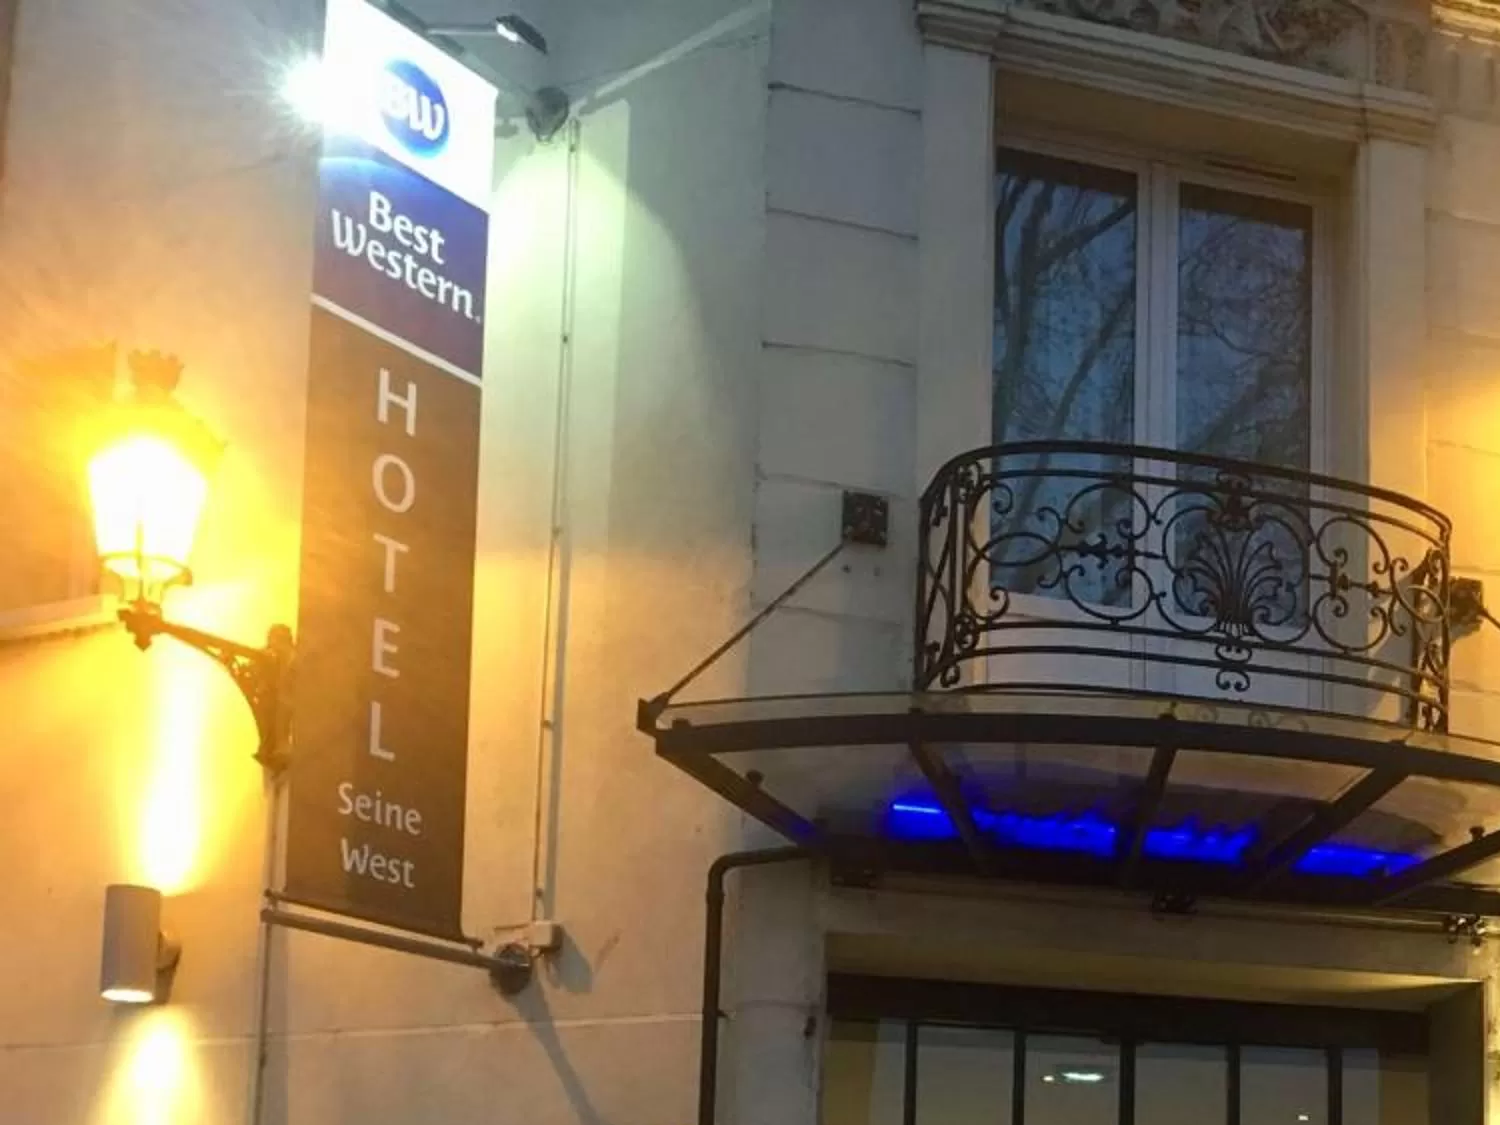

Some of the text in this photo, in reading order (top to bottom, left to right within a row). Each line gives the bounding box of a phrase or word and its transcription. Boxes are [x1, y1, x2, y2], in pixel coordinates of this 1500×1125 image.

[331, 208, 475, 320] Western
[369, 190, 446, 266] Best
[368, 366, 418, 762] HOTEL
[337, 781, 423, 836] Seine
[339, 837, 416, 889] West
